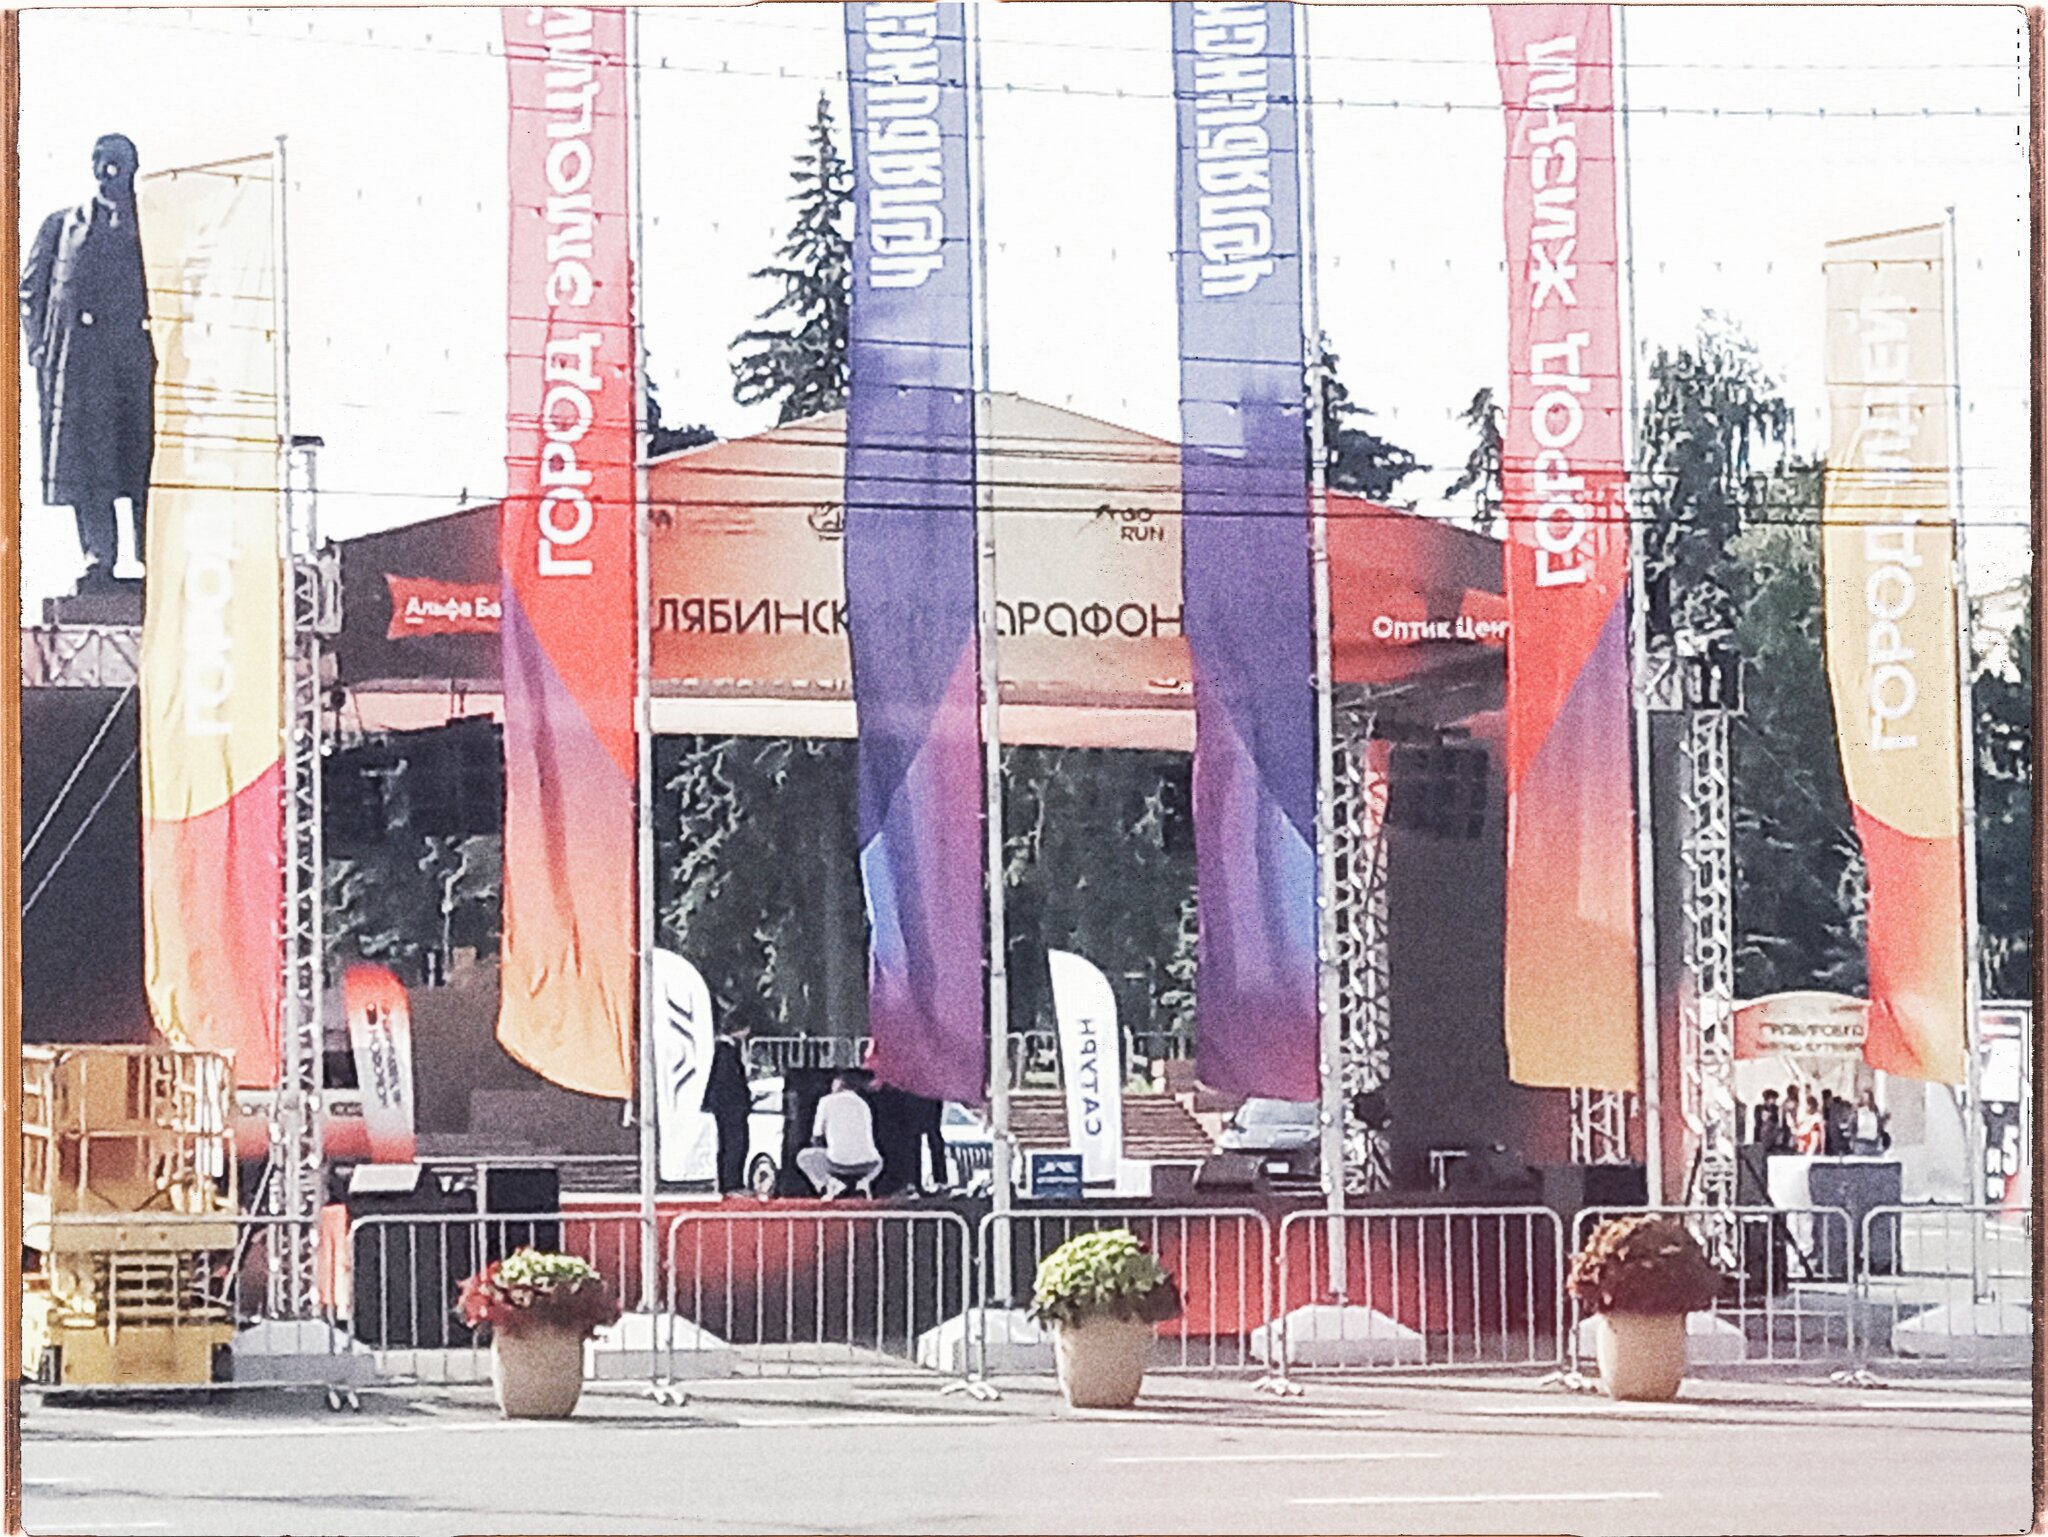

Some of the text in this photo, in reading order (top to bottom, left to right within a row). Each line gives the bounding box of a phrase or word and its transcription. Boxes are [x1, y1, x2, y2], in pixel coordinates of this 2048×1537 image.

[1525, 34, 1591, 588] ГОРОД ЖИЗНИ
[537, 332, 603, 577] ГОРОД
[1121, 526, 1164, 542] RUN
[404, 597, 472, 622] Альфа
[1372, 615, 1451, 640] Оптик
[1865, 512, 1919, 752] ГОРОД
